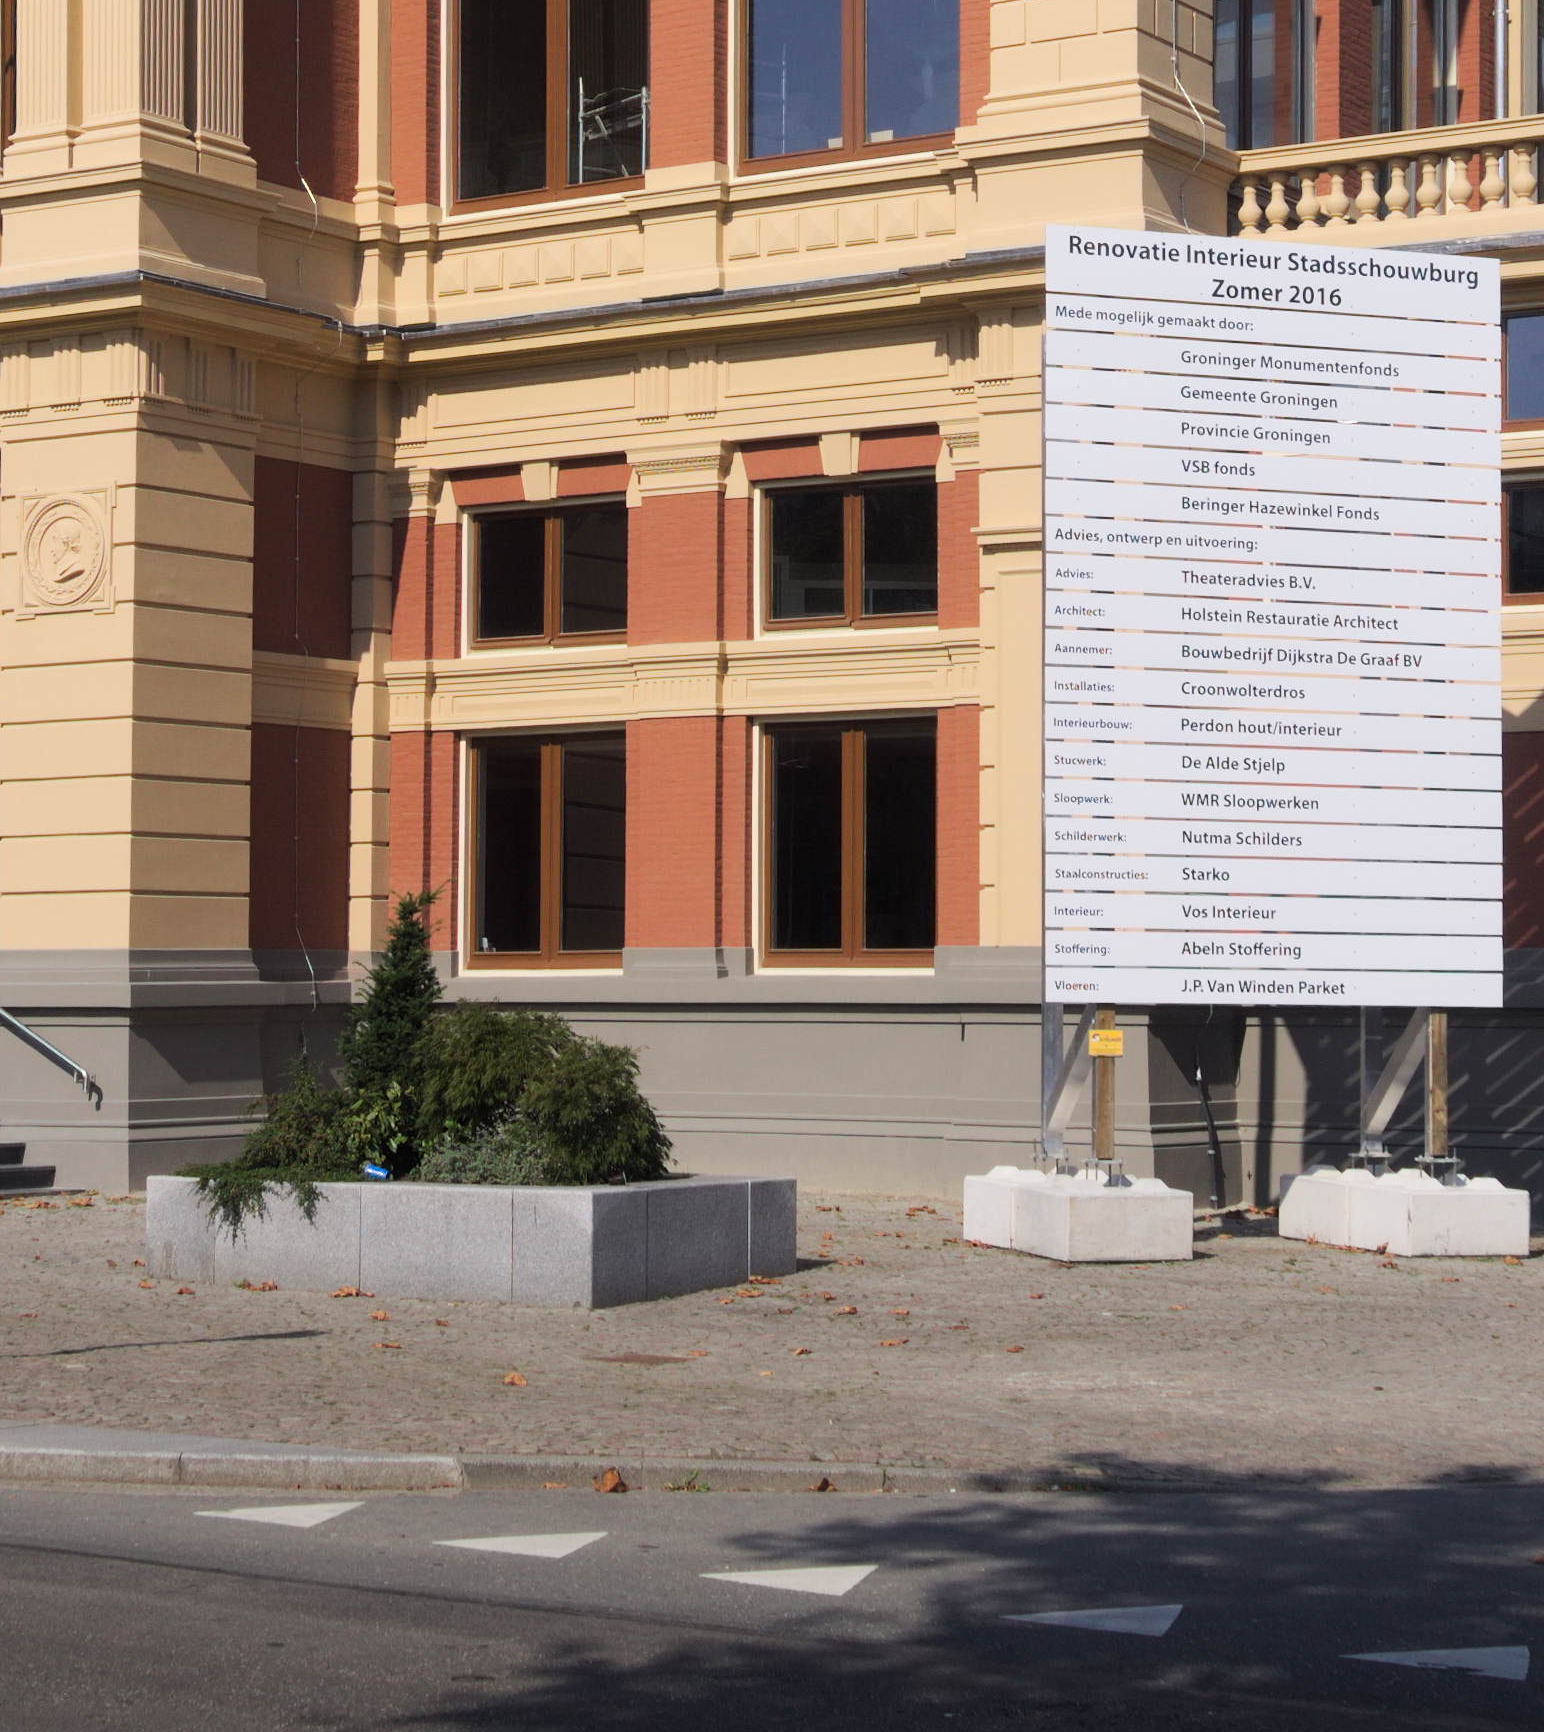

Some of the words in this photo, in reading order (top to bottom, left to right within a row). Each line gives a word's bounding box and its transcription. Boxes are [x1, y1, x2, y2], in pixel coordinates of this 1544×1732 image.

[1069, 235, 1180, 262] Renovatie
[1187, 244, 1282, 270] Interieur
[1288, 252, 1478, 290] Stadsschouwburg
[1212, 279, 1283, 302] Zomer
[1289, 285, 1342, 306] 2016
[1056, 305, 1092, 319] Mede
[1096, 311, 1154, 326] mogelijk
[1158, 316, 1215, 328] gemaakt
[1219, 317, 1253, 331] door:
[1181, 350, 1256, 370] Groninger
[1260, 356, 1399, 377] Monumentenfonds
[1180, 386, 1256, 403] Gemeente
[1260, 391, 1337, 410] Groningen
[1181, 422, 1249, 439] Provincie
[1253, 427, 1330, 446] Groningen
[1181, 459, 1210, 473] VSB
[1214, 461, 1255, 476] fonds
[1182, 496, 1245, 515] Beringer
[1249, 500, 1332, 518] Hazewinkel
[1337, 506, 1379, 520] Fonds
[1055, 528, 1103, 543] Advies,
[1107, 533, 1163, 547] ontwerp
[1166, 536, 1182, 545] en
[1186, 535, 1258, 553] uitvoering:
[1055, 568, 1093, 579] Advies:
[1181, 570, 1285, 588] Theateradvies
[1289, 576, 1316, 589] B.V.
[1055, 605, 1105, 616] Architect:
[1182, 607, 1242, 623] Holstein
[1247, 610, 1329, 627] Restauratie
[1333, 615, 1398, 630] Architect
[1055, 643, 1112, 655] Aannemer:
[1182, 645, 1273, 665] Bouwbedrijf
[1277, 649, 1333, 666] Dijkstra
[1338, 651, 1356, 665] De
[1360, 653, 1400, 666] Graaf
[1403, 654, 1422, 667] BV
[1054, 681, 1114, 692] Installaties:
[1181, 681, 1305, 699] Croonwolterdros
[1054, 718, 1132, 729] Interieurbouw:
[1181, 718, 1233, 733] Perdon
[1238, 720, 1342, 736] hout/interieur
[1054, 755, 1106, 766] Stucwerk:
[1182, 755, 1201, 769] De
[1206, 756, 1239, 770] Alde
[1243, 757, 1285, 775] Stjelp
[1054, 793, 1112, 805] Sloopwerk:
[1181, 793, 1220, 807] WMR
[1224, 794, 1319, 811] Sloopwerken
[1055, 831, 1126, 842] Schilderwerk:
[1182, 830, 1231, 844] Nutma
[1236, 832, 1302, 846] Schilders
[1055, 869, 1148, 879] Staalconstructies:
[1182, 867, 1230, 881] Starko
[1054, 906, 1103, 916] Interieur:
[1182, 905, 1208, 918] Vos
[1212, 905, 1276, 919] Interieur
[1055, 944, 1109, 956] Stoffering:
[1181, 941, 1224, 955] Abeln
[1229, 942, 1301, 960] Stoffering
[1055, 980, 1099, 990] Vloeren:
[1181, 979, 1204, 992] J.P.
[1207, 980, 1234, 993] Van
[1238, 980, 1294, 994] Winden
[1299, 981, 1345, 994] Parket
